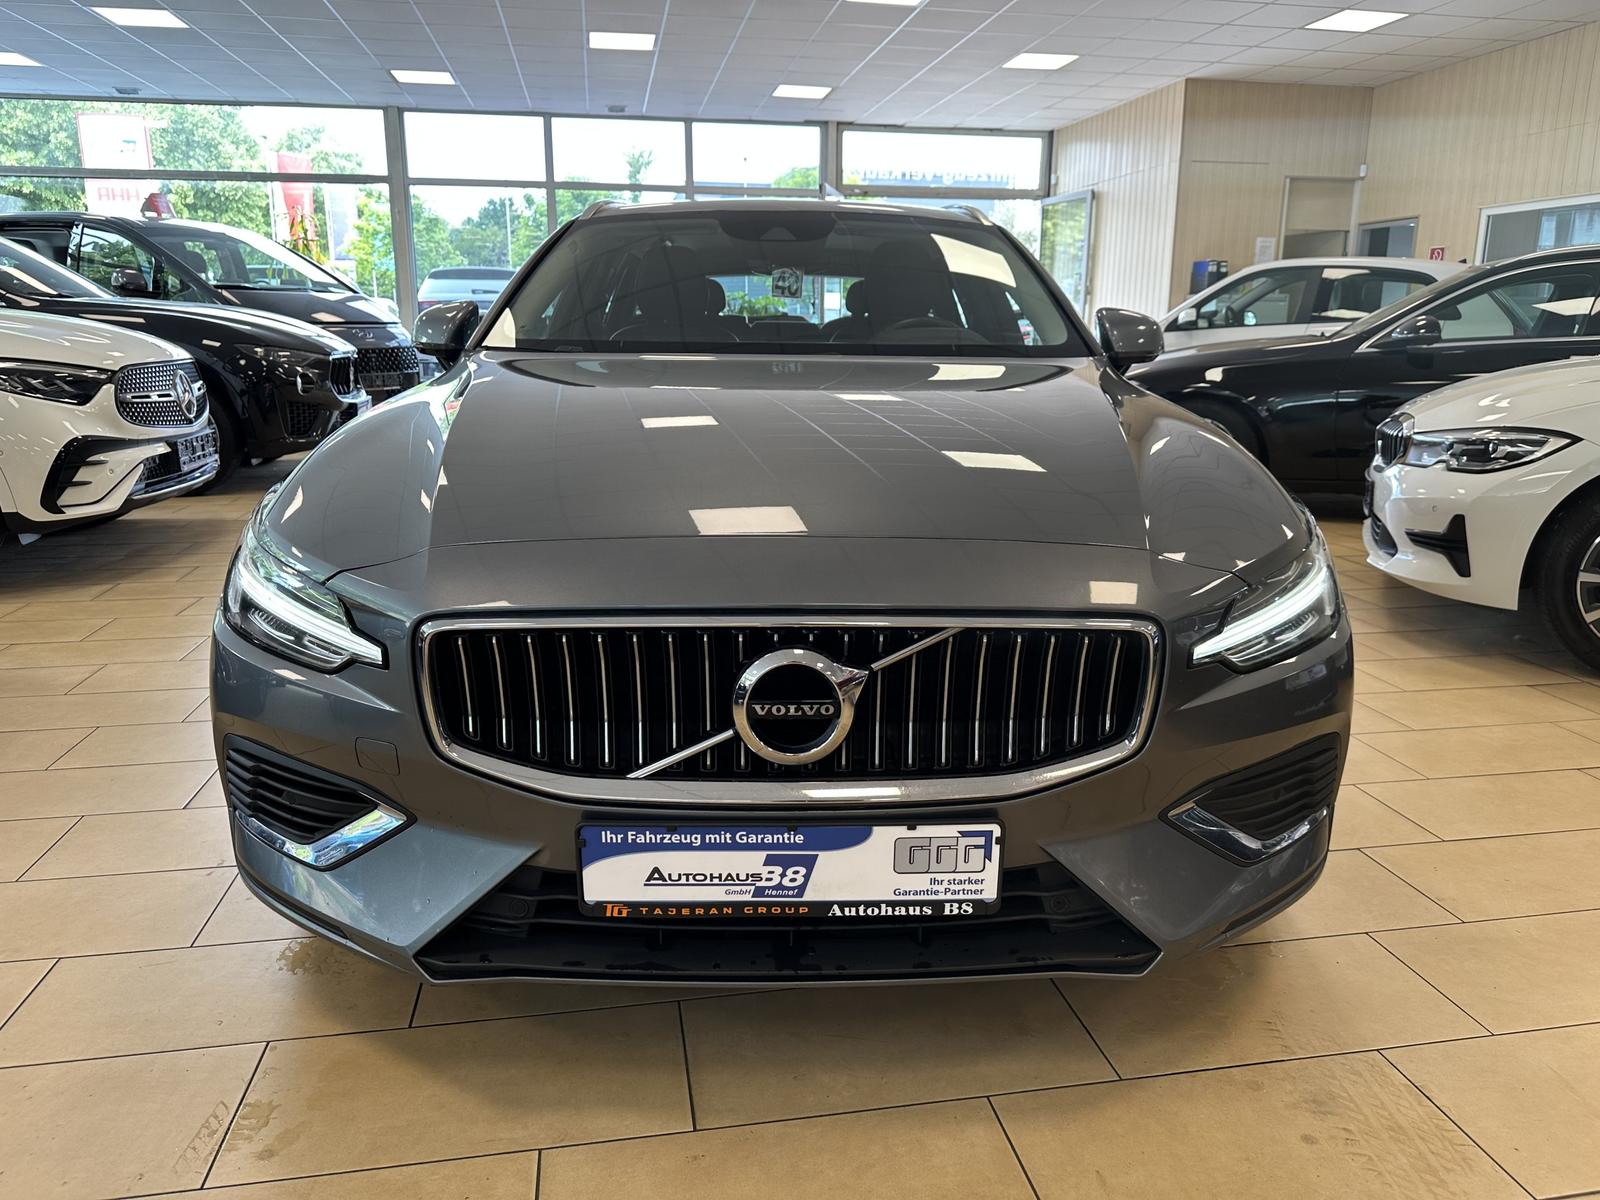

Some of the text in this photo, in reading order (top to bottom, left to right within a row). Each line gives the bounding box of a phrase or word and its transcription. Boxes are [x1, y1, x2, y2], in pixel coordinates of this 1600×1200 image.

[752, 704, 835, 716] VOLVO
[601, 831, 805, 847] Ihr Fahrzeug mit Garantie
[929, 877, 986, 886] Ihr starker
[724, 888, 799, 896] GmbH Hennef
[893, 887, 985, 897] Garantie-Partner
[639, 906, 734, 915] TAJERAN
[743, 905, 810, 915] GROUP
[827, 902, 974, 917] Autohaus B8
